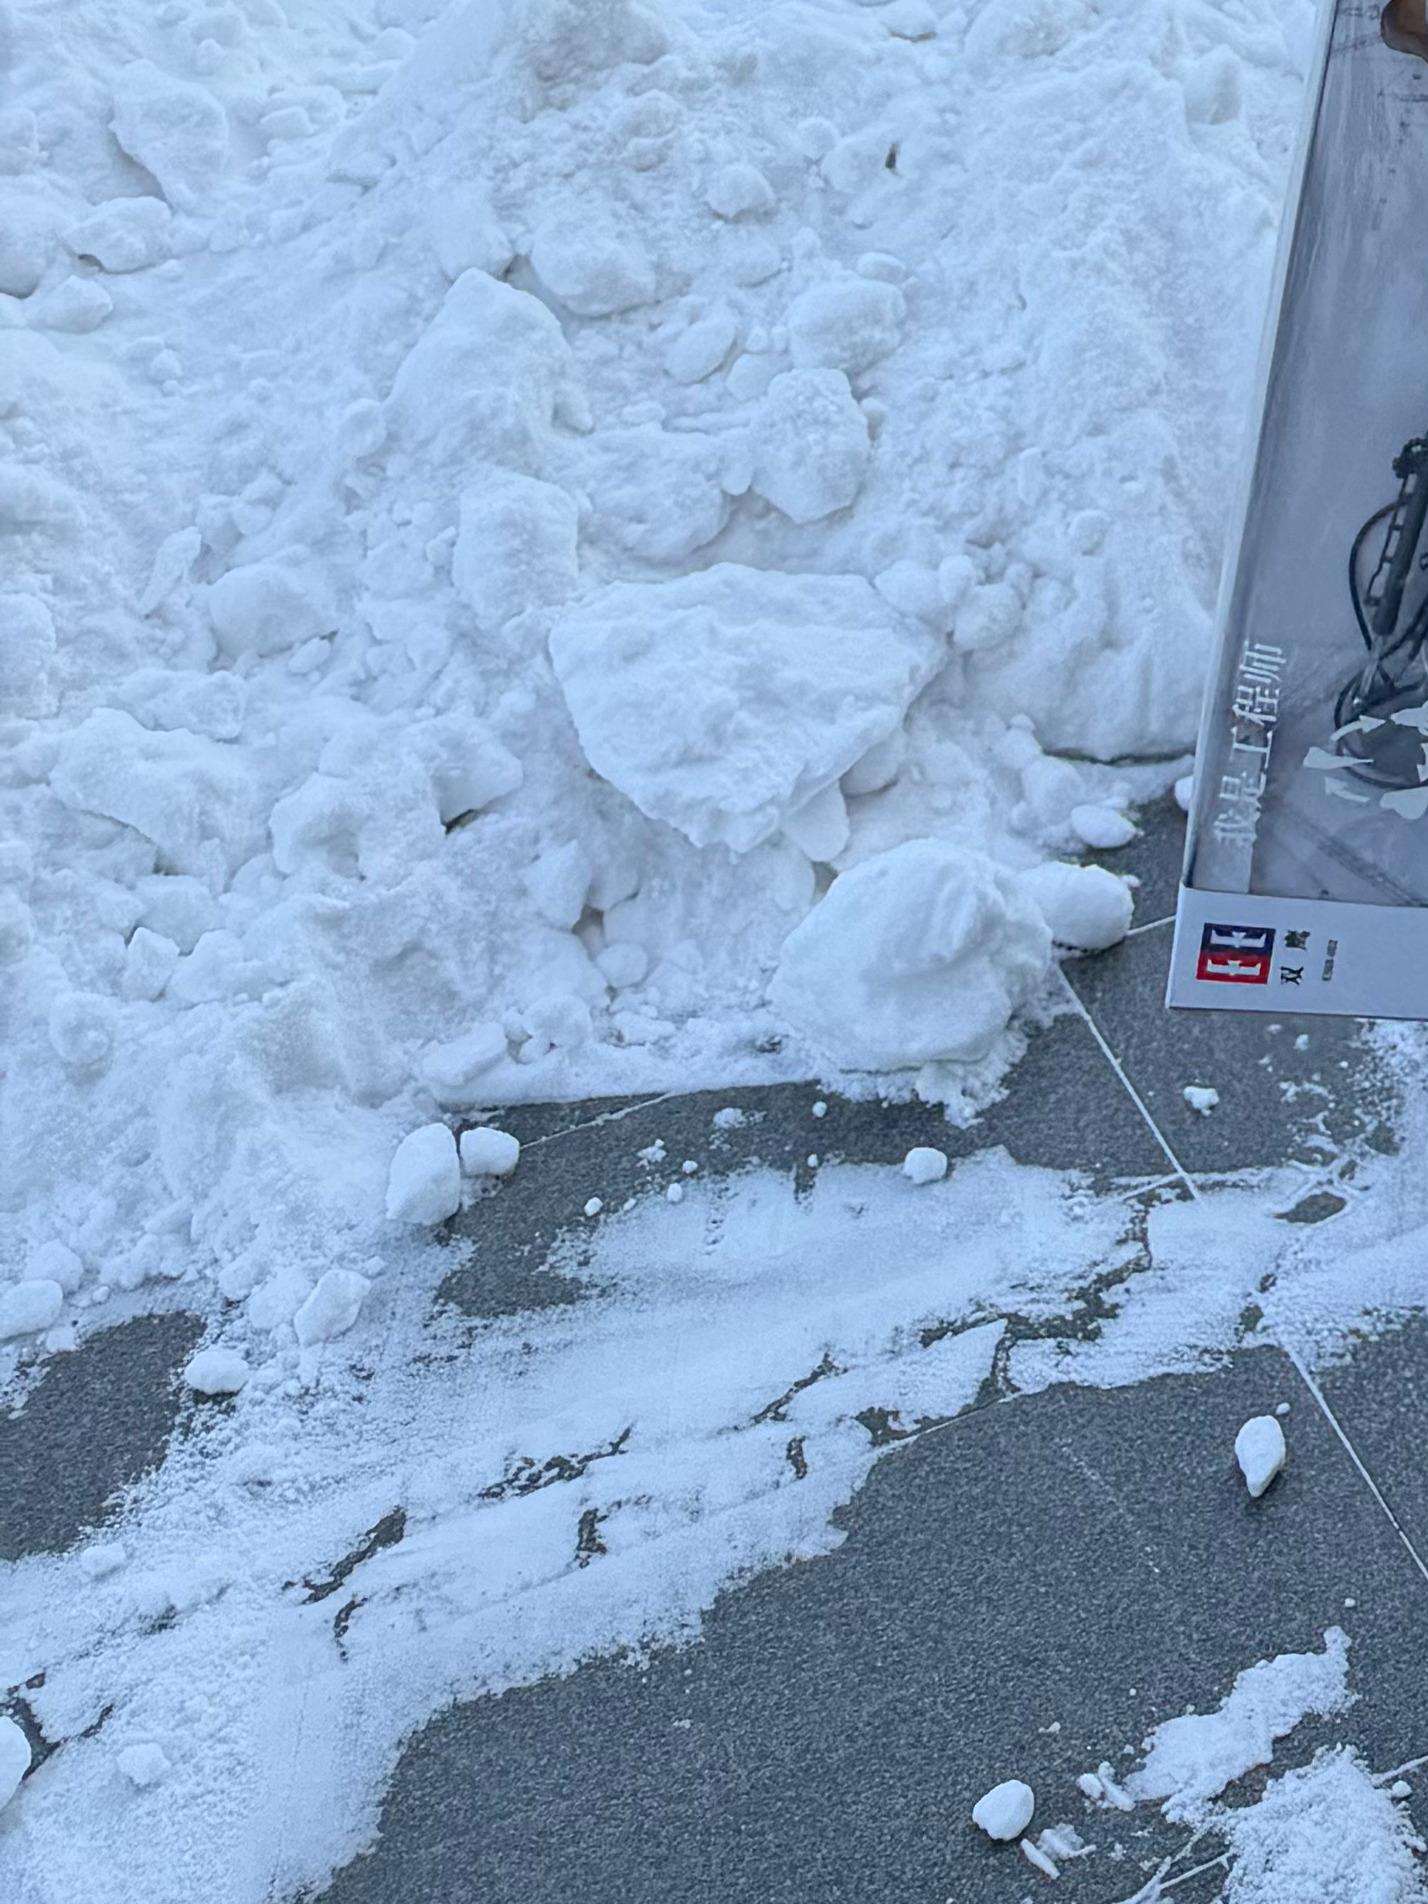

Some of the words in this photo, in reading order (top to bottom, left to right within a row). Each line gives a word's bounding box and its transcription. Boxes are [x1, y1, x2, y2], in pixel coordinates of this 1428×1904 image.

[1213, 641, 1288, 848] 我是工程师
